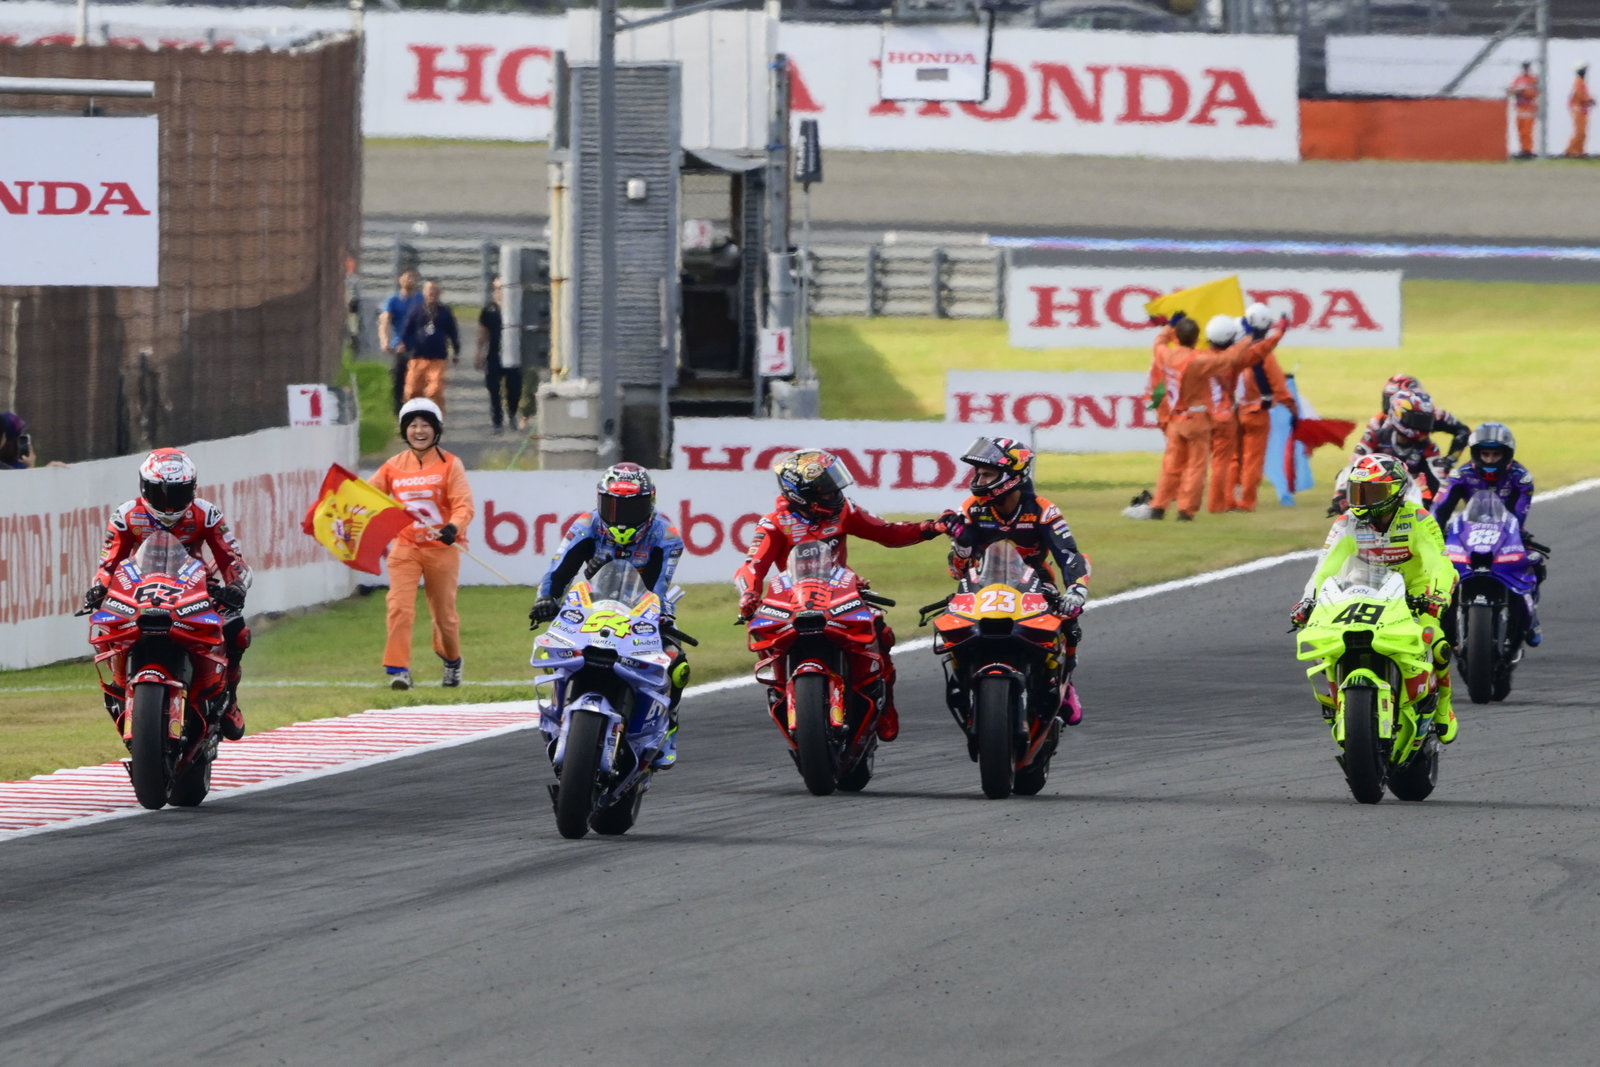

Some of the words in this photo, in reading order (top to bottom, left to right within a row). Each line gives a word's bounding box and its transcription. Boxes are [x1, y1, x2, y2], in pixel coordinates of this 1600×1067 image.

[887, 52, 978, 66] HONDA
[1029, 285, 1382, 331] HODA
[133, 582, 184, 606] 63
[980, 590, 1016, 613] 23
[106, 597, 136, 615] Lenovo
[176, 600, 210, 616] Lenovo
[760, 605, 790, 619] Lenovo
[830, 600, 861, 615] Lenovo
[1331, 602, 1386, 625] 49
[580, 610, 631, 639] 54
[632, 638, 660, 647] Unibat
